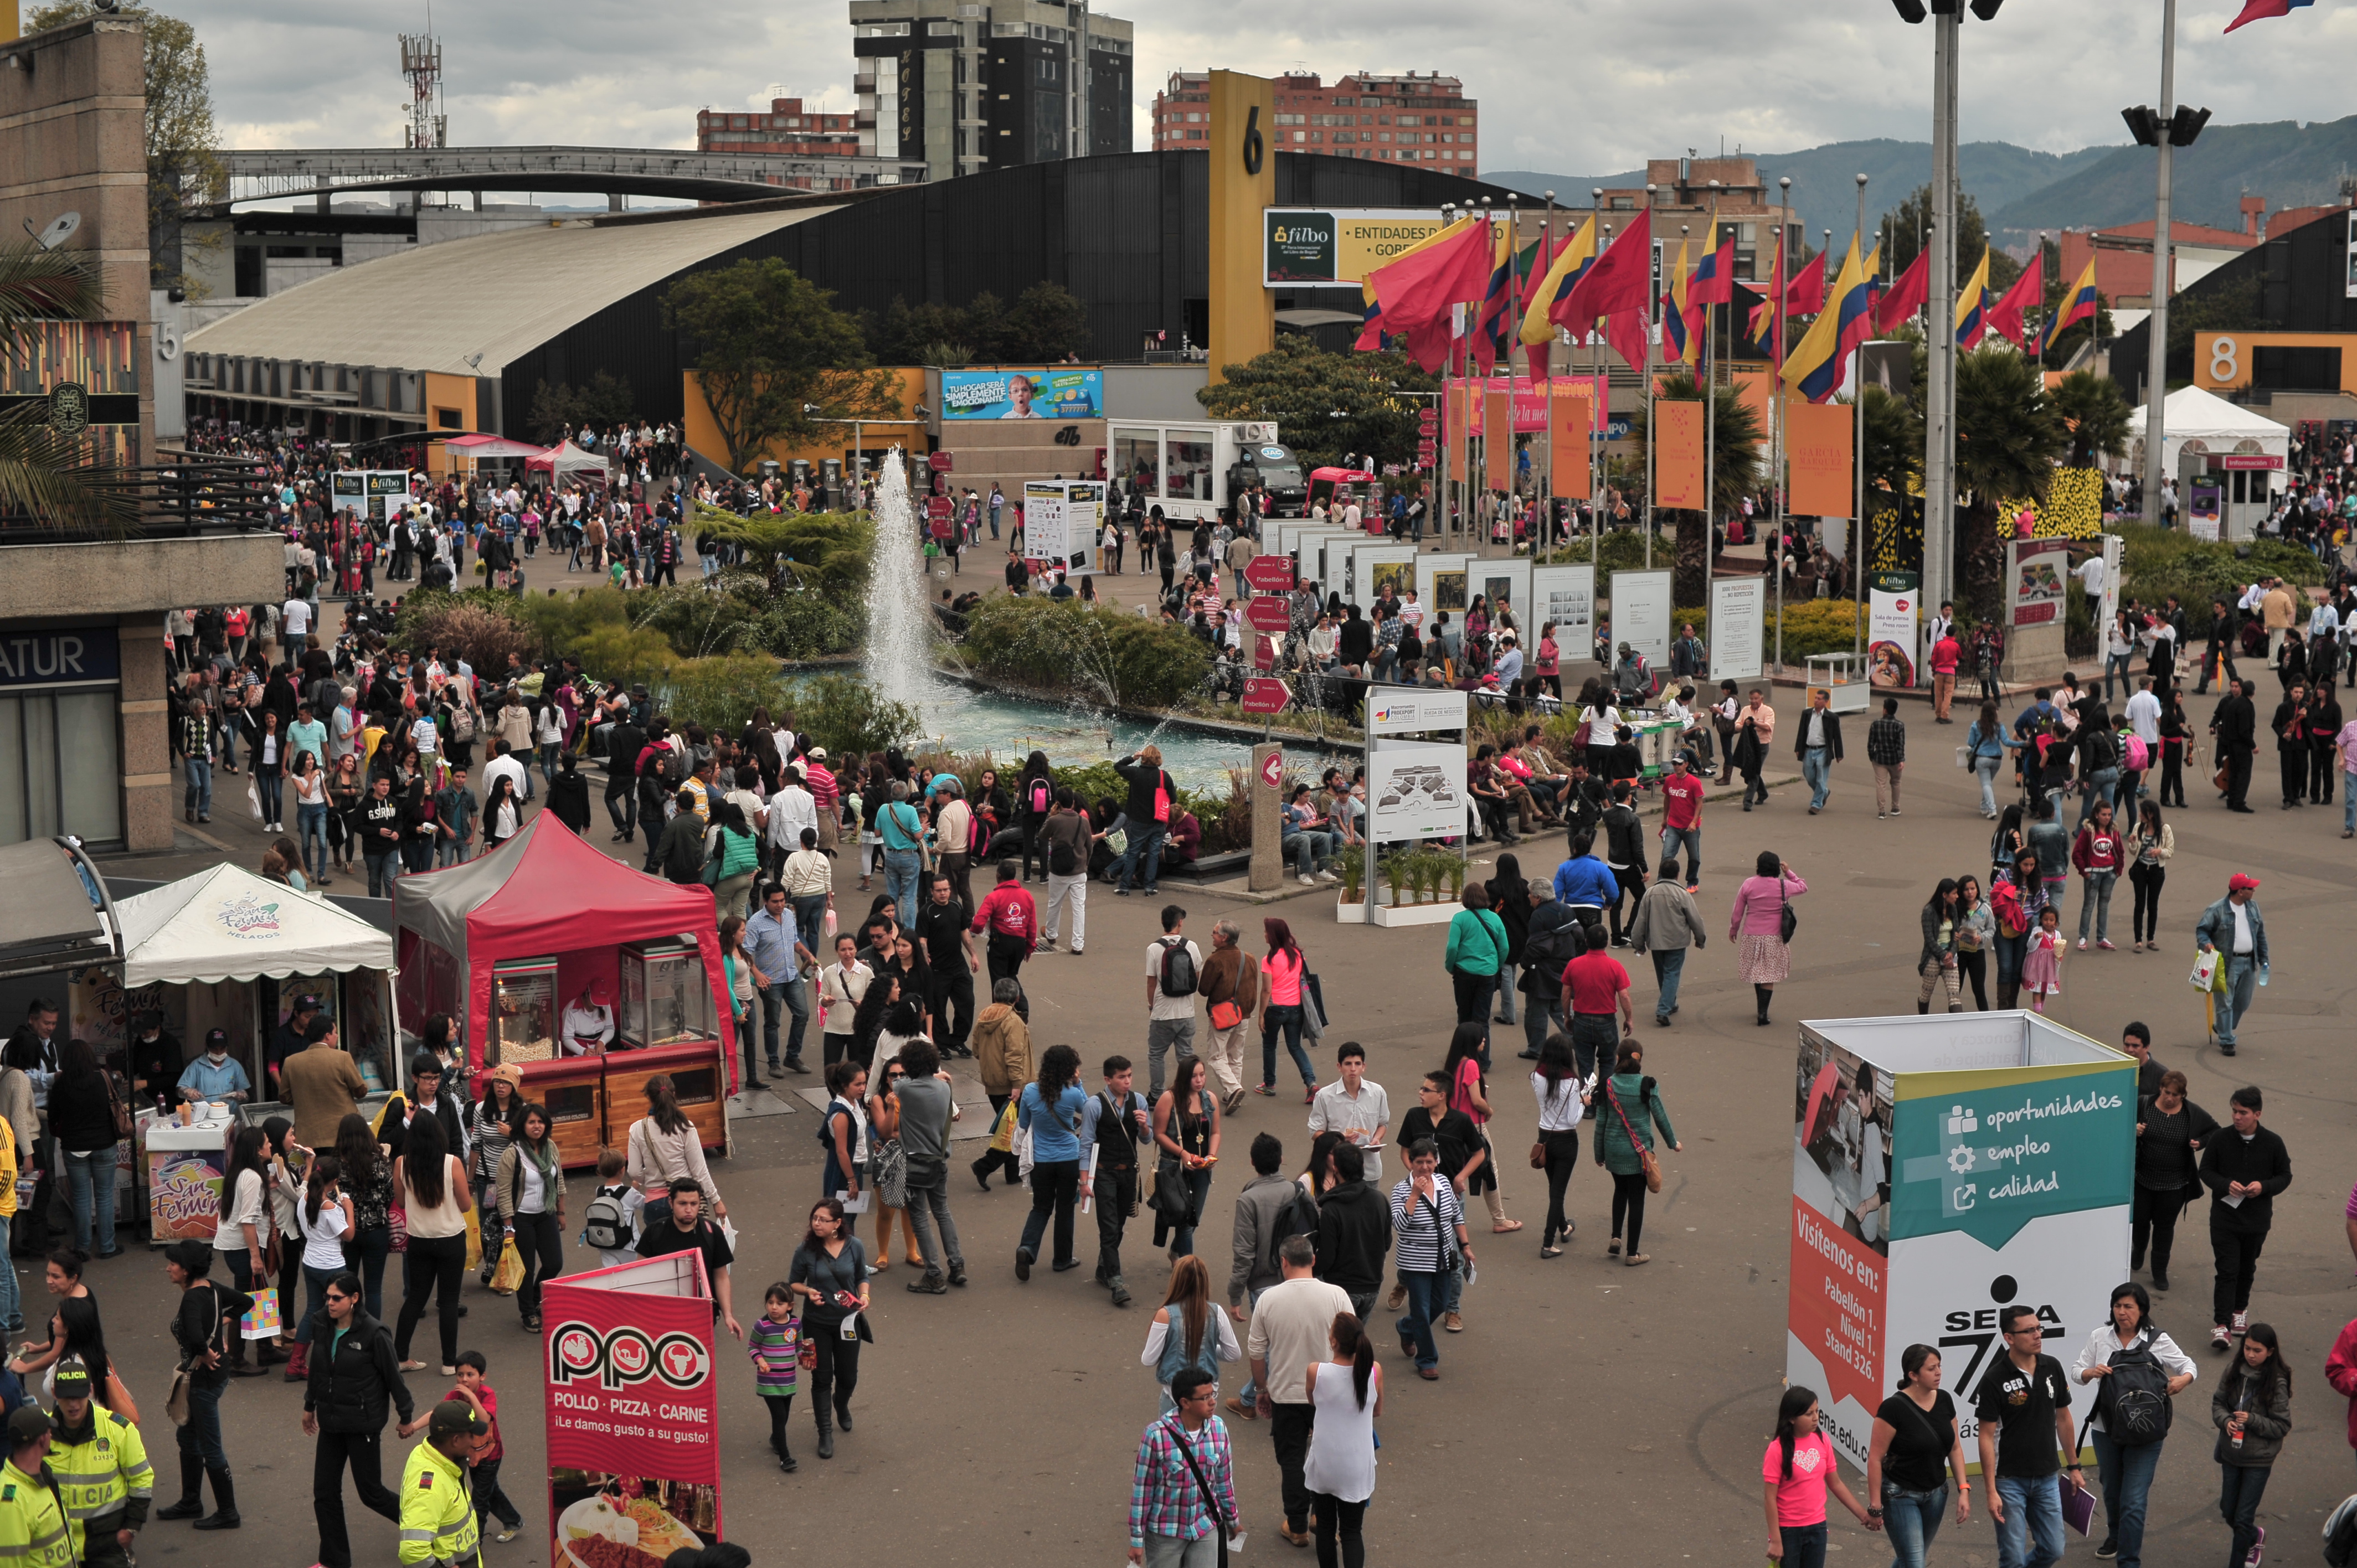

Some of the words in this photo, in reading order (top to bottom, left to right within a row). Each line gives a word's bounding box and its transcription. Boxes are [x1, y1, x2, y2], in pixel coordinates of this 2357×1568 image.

[1243, 106, 1264, 176] 6
[1287, 228, 1328, 244] filbo
[1355, 227, 1425, 239] ENTIDADES
[157, 322, 178, 360] 5
[2210, 336, 2237, 381] 8
[945, 387, 1006, 402] SIMPLEMENTE
[960, 383, 986, 391] HOGAR
[986, 378, 1005, 389] SERÁ
[952, 395, 1006, 408] EMOCIONANTE.
[378, 478, 399, 488] filbo
[1282, 559, 1289, 570] 3
[1886, 576, 1906, 585] filbo
[1247, 681, 1255, 692] 6
[227, 931, 280, 939] HELADOS
[1987, 1091, 2122, 1132] oportunidades
[1988, 1134, 2050, 1165] empleo
[166, 1178, 209, 1197] San
[1989, 1170, 2059, 1199] calidad
[1797, 1208, 1854, 1275] Visítenos
[1857, 1261, 1879, 1293] en:
[1825, 1276, 1865, 1323] Pabellón
[1869, 1309, 1876, 1331] 1.
[1945, 1304, 2062, 1332] SEA
[1840, 1313, 1865, 1349] Nivel
[1867, 1334, 1875, 1356] 1.
[1825, 1327, 1852, 1365] Stand
[1854, 1350, 1875, 1383] 326.
[57, 1371, 87, 1380] POLICIA
[2003, 1378, 2025, 1393] GER
[554, 1391, 599, 1411] POLLO
[611, 1397, 650, 1417] PIZZA
[660, 1404, 708, 1423] CARNE
[574, 1417, 611, 1433] damos
[614, 1422, 645, 1437] gusto
[648, 1428, 655, 1438] a
[657, 1429, 671, 1440] su
[673, 1430, 709, 1444] gusto!
